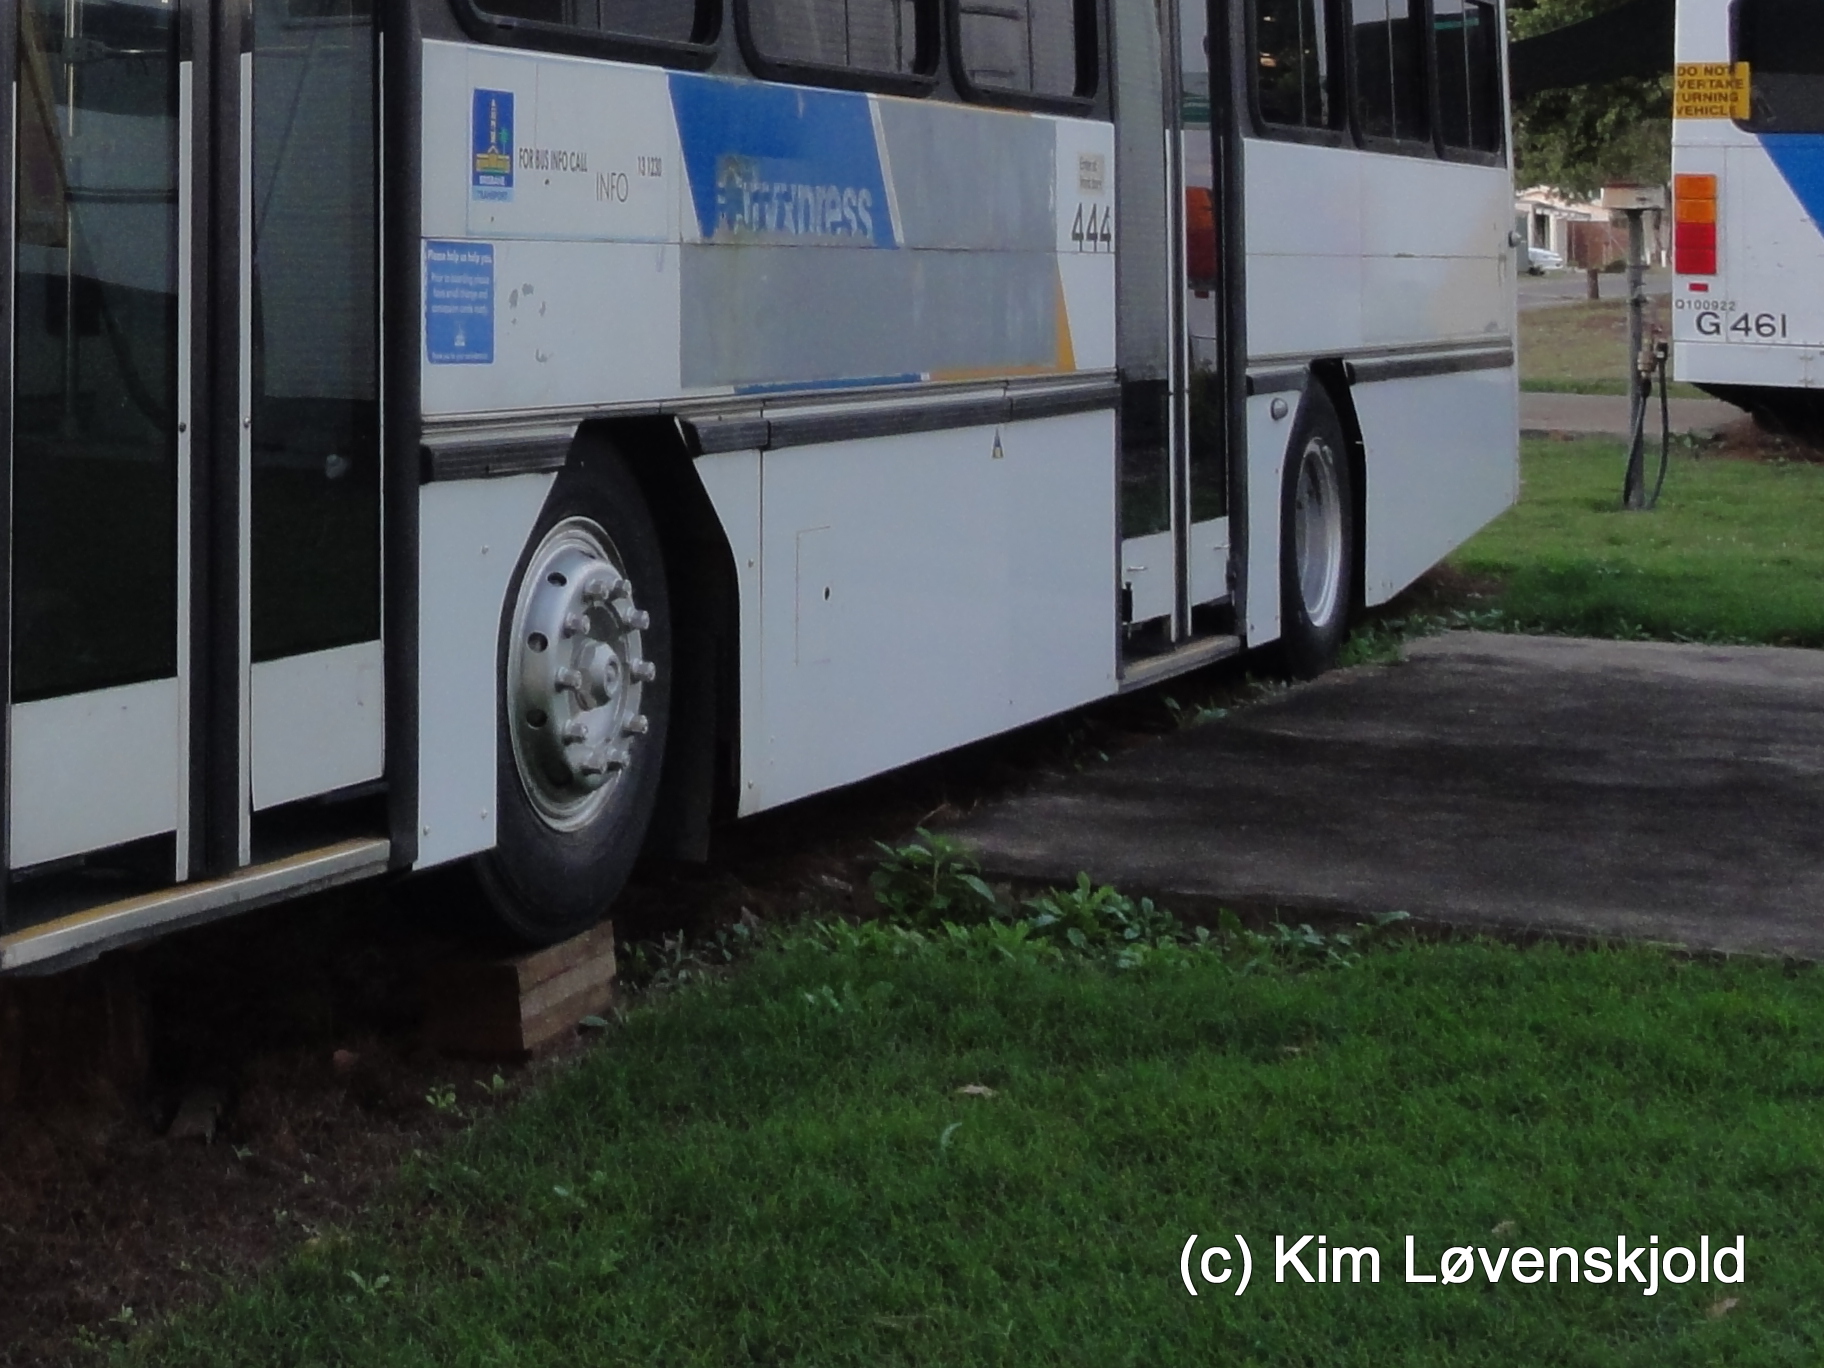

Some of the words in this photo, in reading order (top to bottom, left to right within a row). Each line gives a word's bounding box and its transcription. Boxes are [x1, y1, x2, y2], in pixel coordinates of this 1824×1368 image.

[1677, 66, 1698, 77] DO
[1676, 78, 1744, 90] VERTAKE
[1676, 91, 1739, 103] URNING
[1675, 105, 1737, 116] VEHICLE
[518, 148, 534, 169] FOR
[534, 149, 550, 171] BUS
[550, 150, 569, 172] INFO
[569, 152, 588, 173] CALL
[596, 172, 629, 203] INFO
[1071, 202, 1112, 253] 444
[1675, 298, 1737, 312] Q100922
